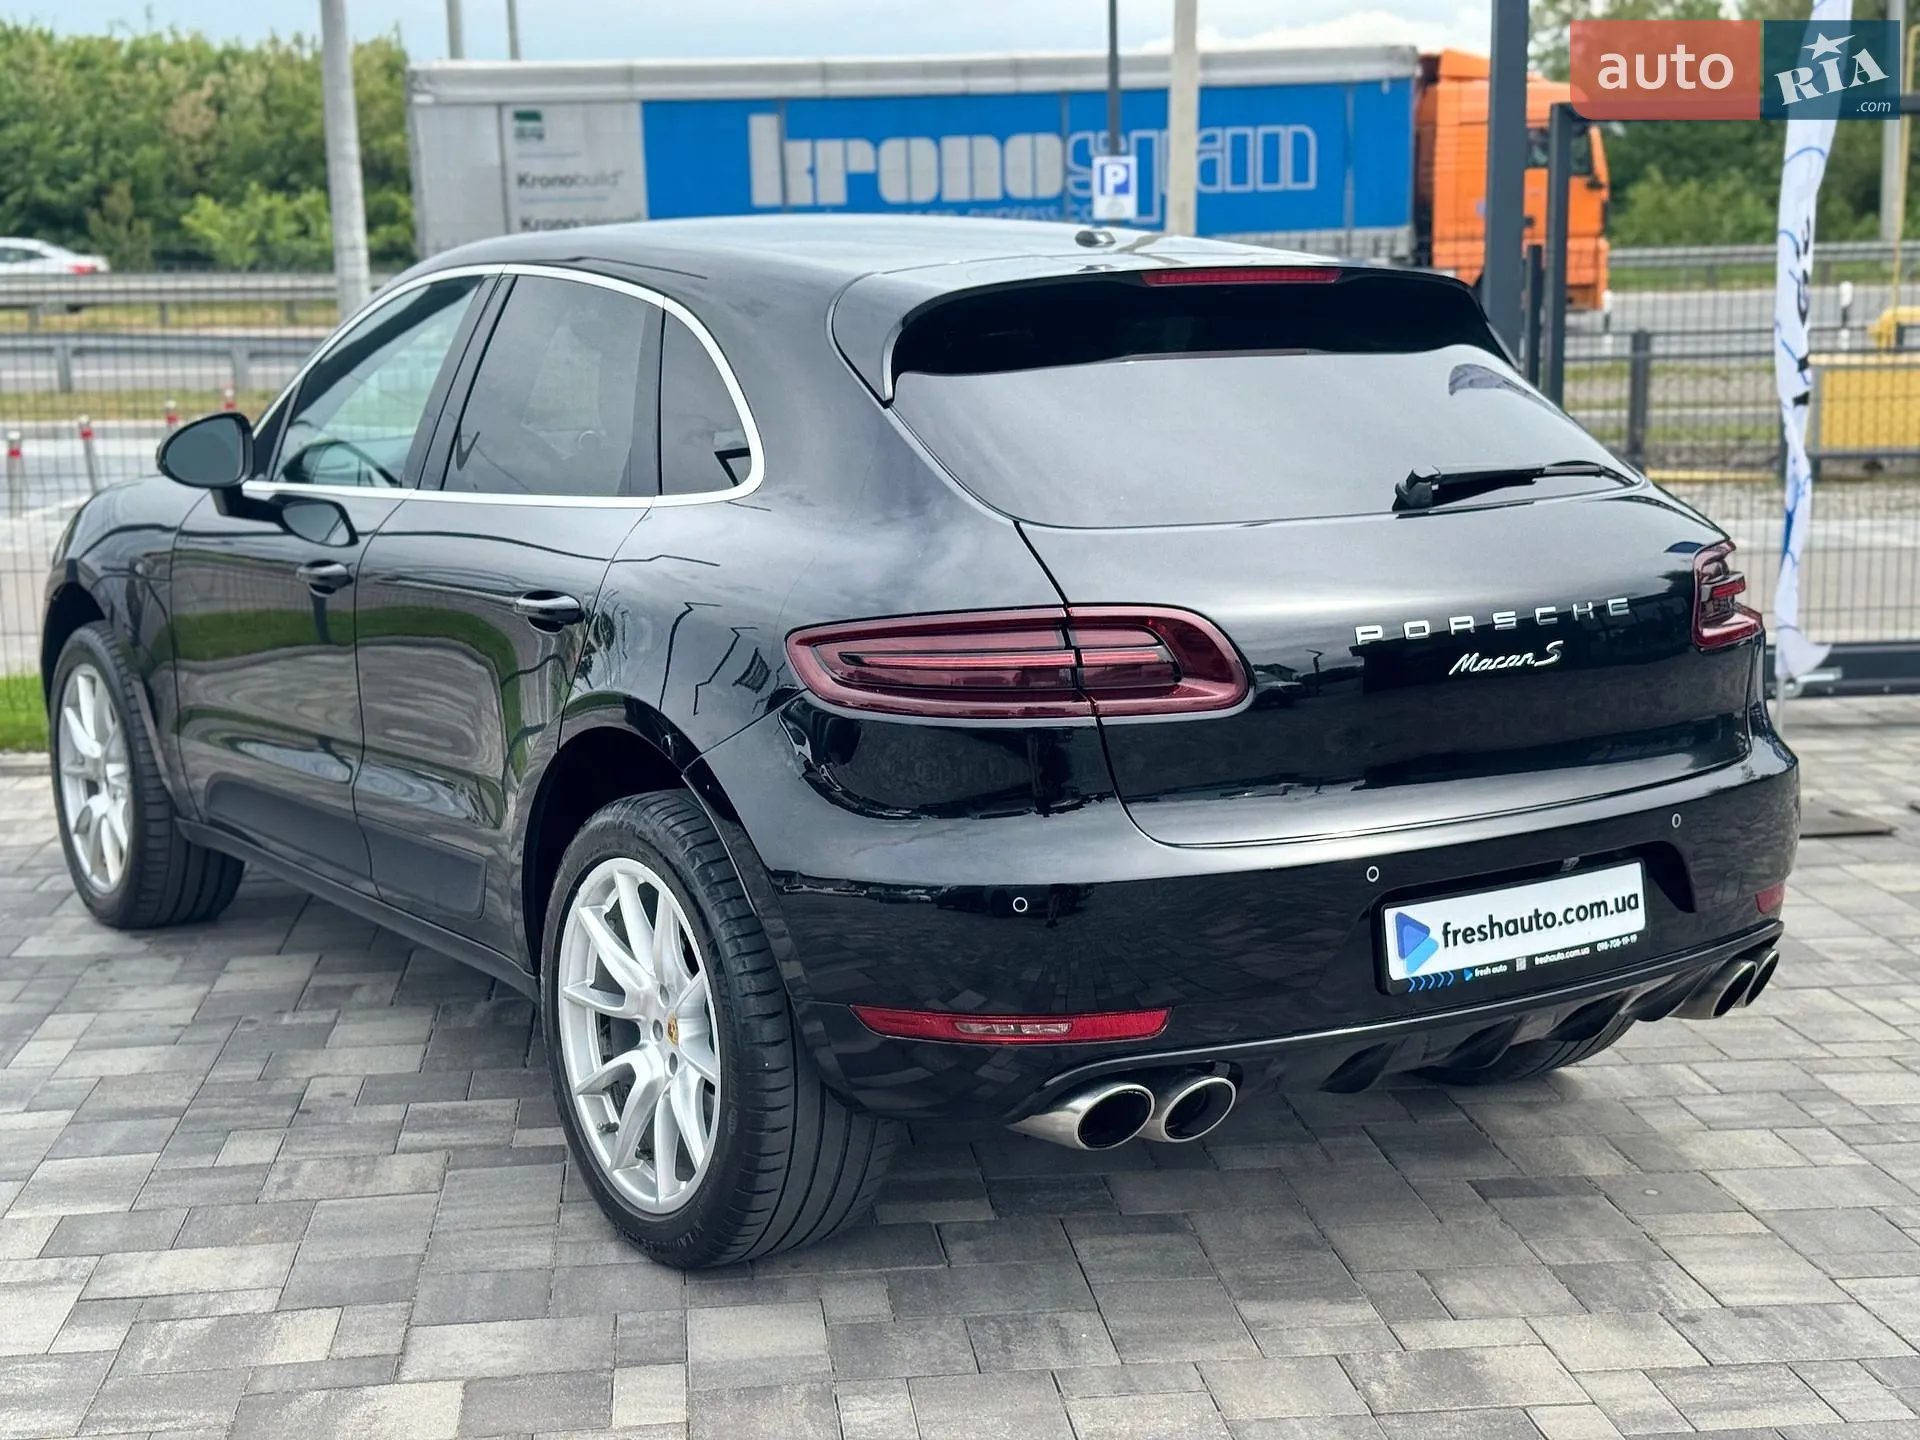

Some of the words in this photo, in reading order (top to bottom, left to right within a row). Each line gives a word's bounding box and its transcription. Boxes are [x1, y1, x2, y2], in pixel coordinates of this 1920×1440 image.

[1103, 163, 1128, 196] P
[1355, 597, 1631, 645] PORSCHE
[1449, 651, 1535, 676] Macan
[1534, 640, 1563, 667] S
[1442, 893, 1639, 948] freshauto.com.ua
[1474, 965, 1491, 977] fresh
[1491, 964, 1508, 974] auto
[1534, 946, 1590, 965] freshauto.com.ua
